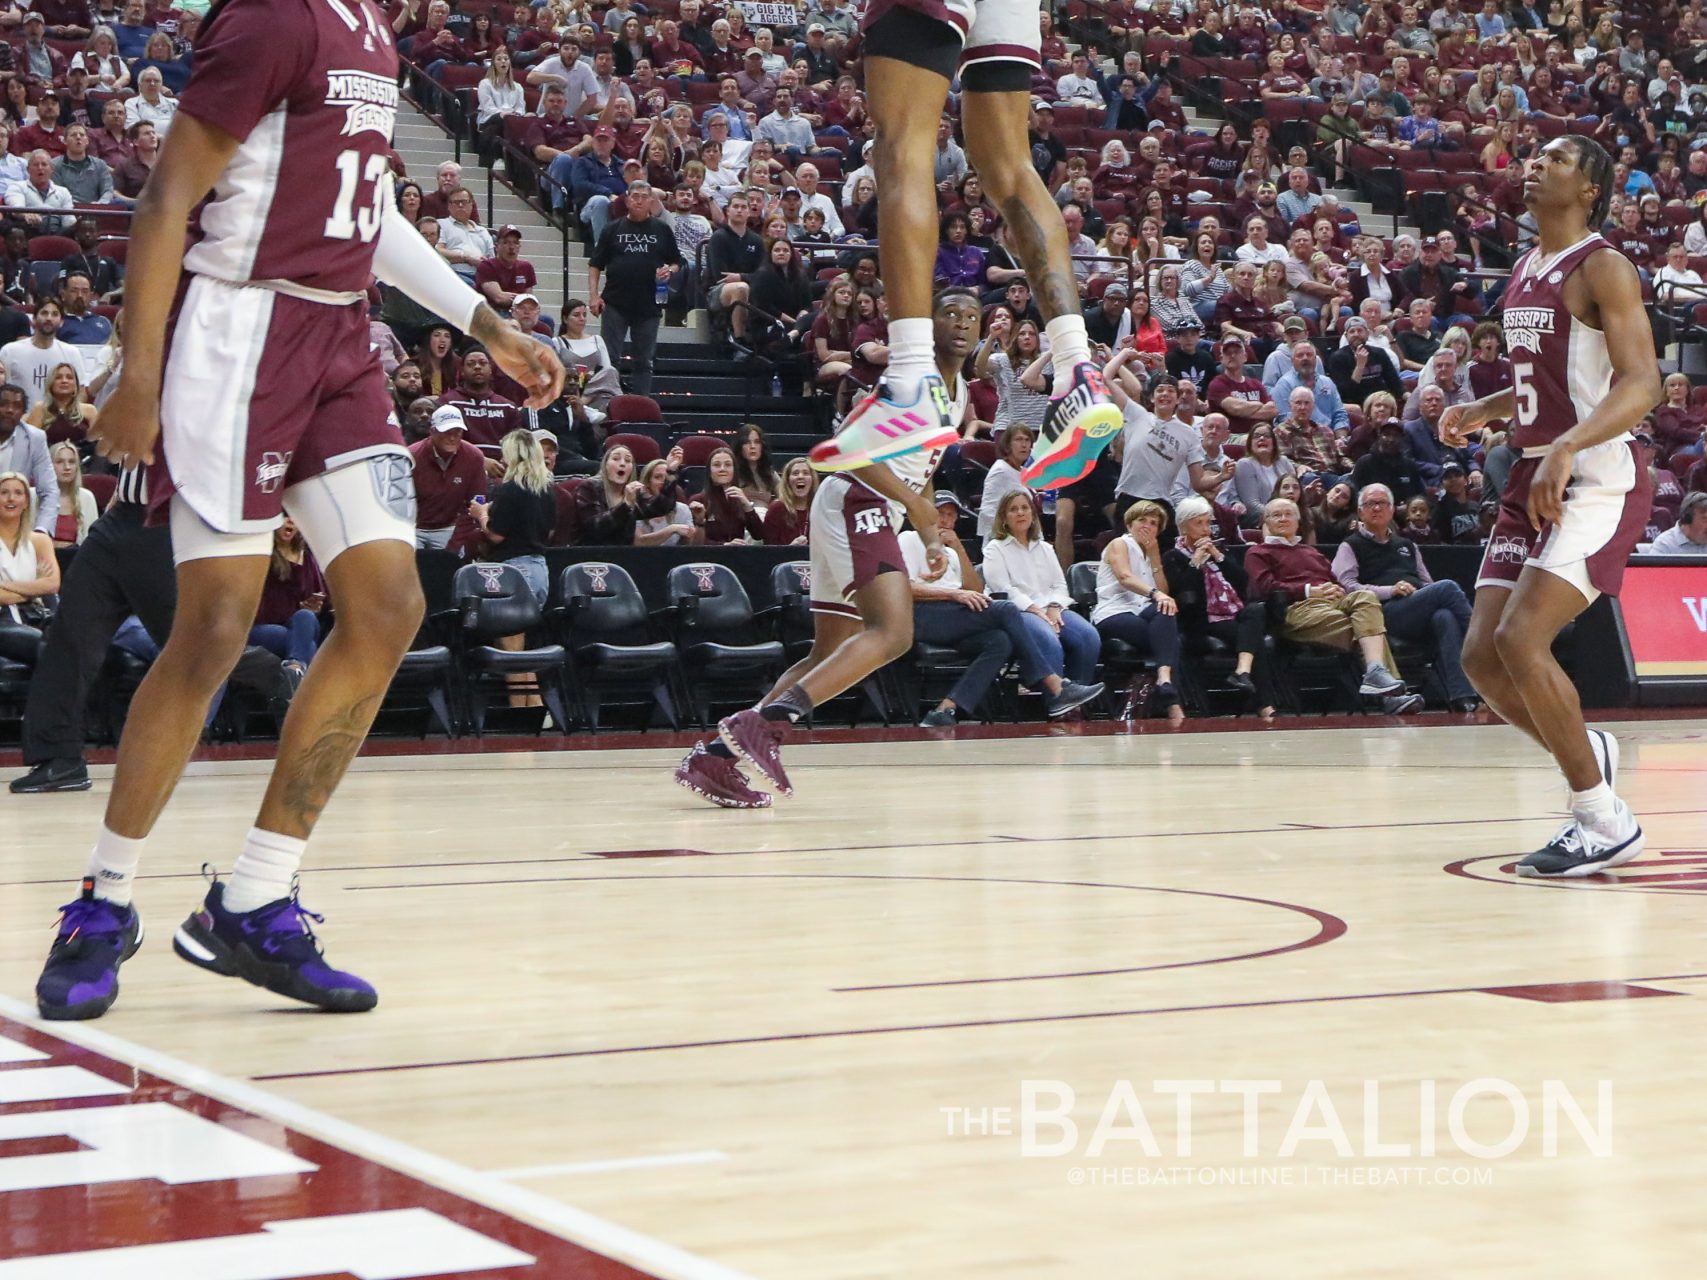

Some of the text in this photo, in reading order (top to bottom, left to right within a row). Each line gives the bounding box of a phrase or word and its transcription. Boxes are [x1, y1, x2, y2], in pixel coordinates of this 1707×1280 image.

[756, 4, 774, 14] GIG
[760, 14, 794, 24] AGGIES
[324, 150, 387, 243] 13
[617, 234, 657, 244] TEXAS
[624, 244, 648, 253] A&M
[1514, 363, 1538, 426] 5
